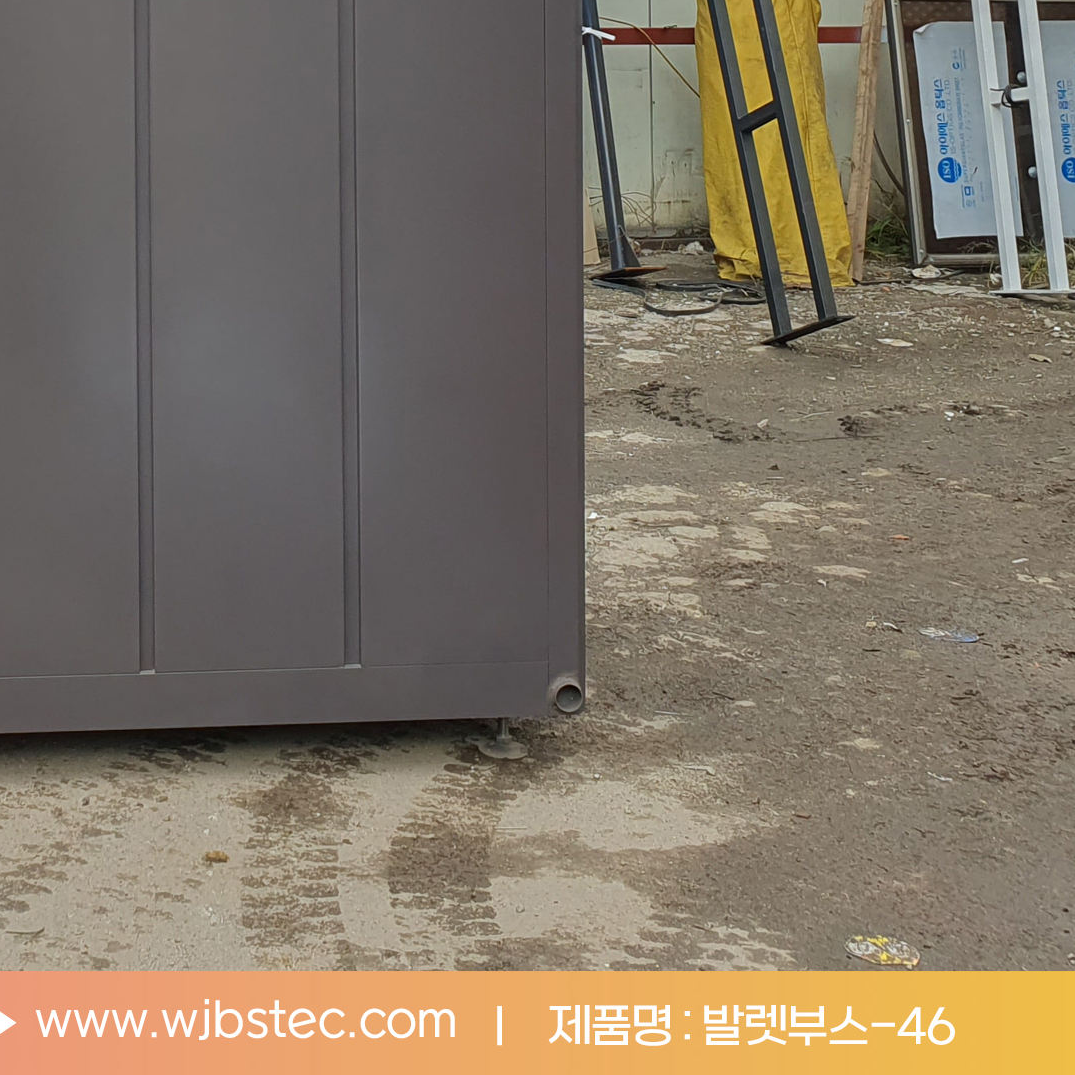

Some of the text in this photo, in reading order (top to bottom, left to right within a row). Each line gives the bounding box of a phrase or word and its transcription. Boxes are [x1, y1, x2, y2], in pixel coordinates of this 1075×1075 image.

[935, 112, 949, 155] 아이에스
[1059, 113, 1071, 155] 아이에스
[942, 160, 952, 179] ISO
[1066, 160, 1075, 179] ISO
